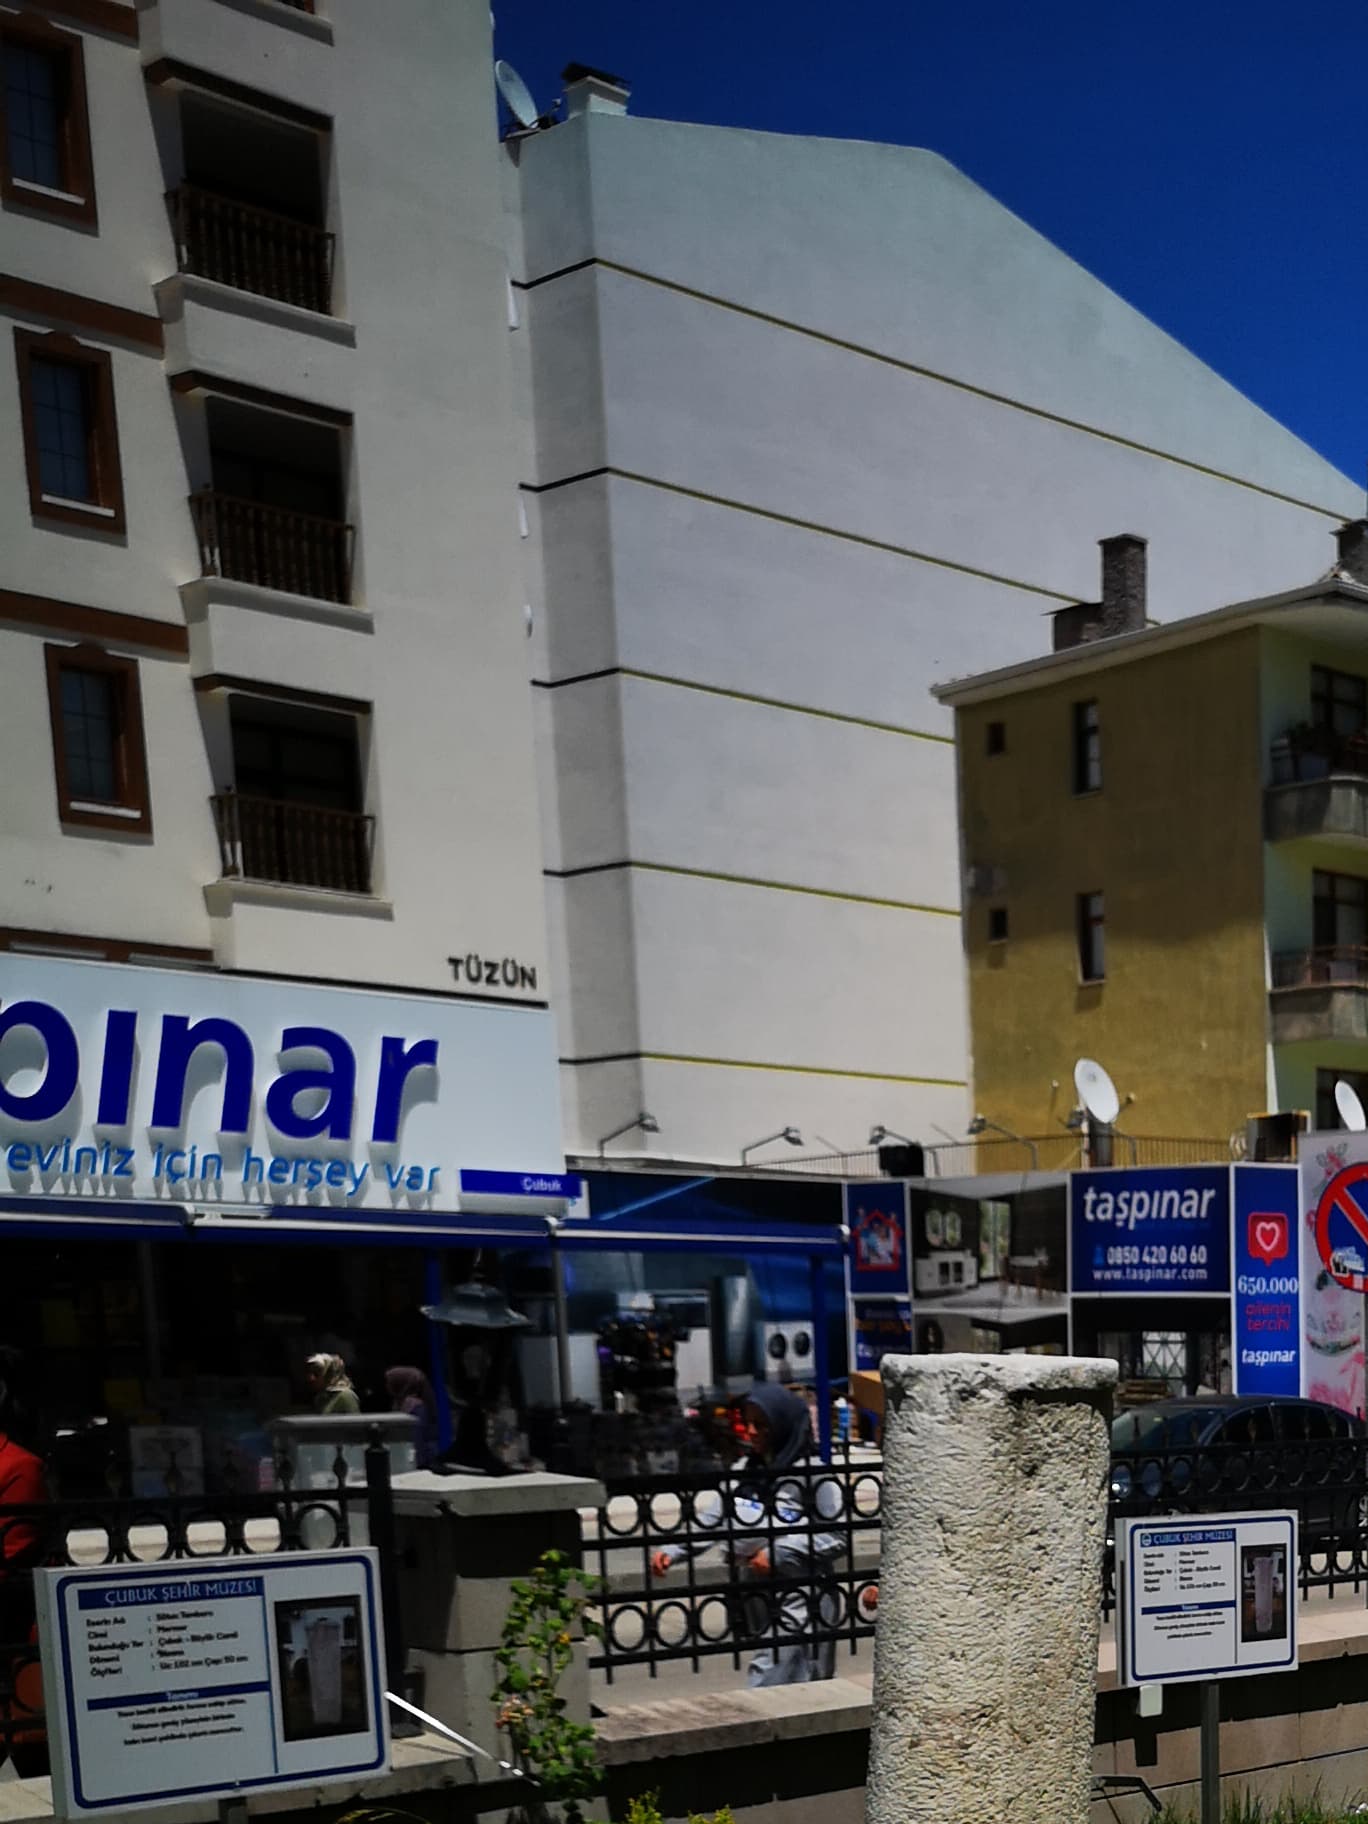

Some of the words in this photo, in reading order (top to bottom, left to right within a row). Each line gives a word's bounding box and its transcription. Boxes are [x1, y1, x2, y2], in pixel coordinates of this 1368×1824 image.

[446, 954, 539, 990] TÜZÜN
[7, 1137, 135, 1180] eviniz
[154, 1143, 223, 1185] için
[243, 1147, 370, 1197] herşey
[385, 1161, 441, 1193] var
[1083, 1186, 1216, 1230] taşpınar
[1107, 1246, 1139, 1265] 0850
[1142, 1246, 1166, 1264] 420
[1169, 1245, 1187, 1264] 60
[1189, 1245, 1207, 1264] 60
[1237, 1275, 1299, 1296] 650.000
[1241, 1349, 1296, 1367] taşpınar
[104, 1587, 158, 1607] ÇUBUK
[161, 1580, 201, 1602] ŞEHİR
